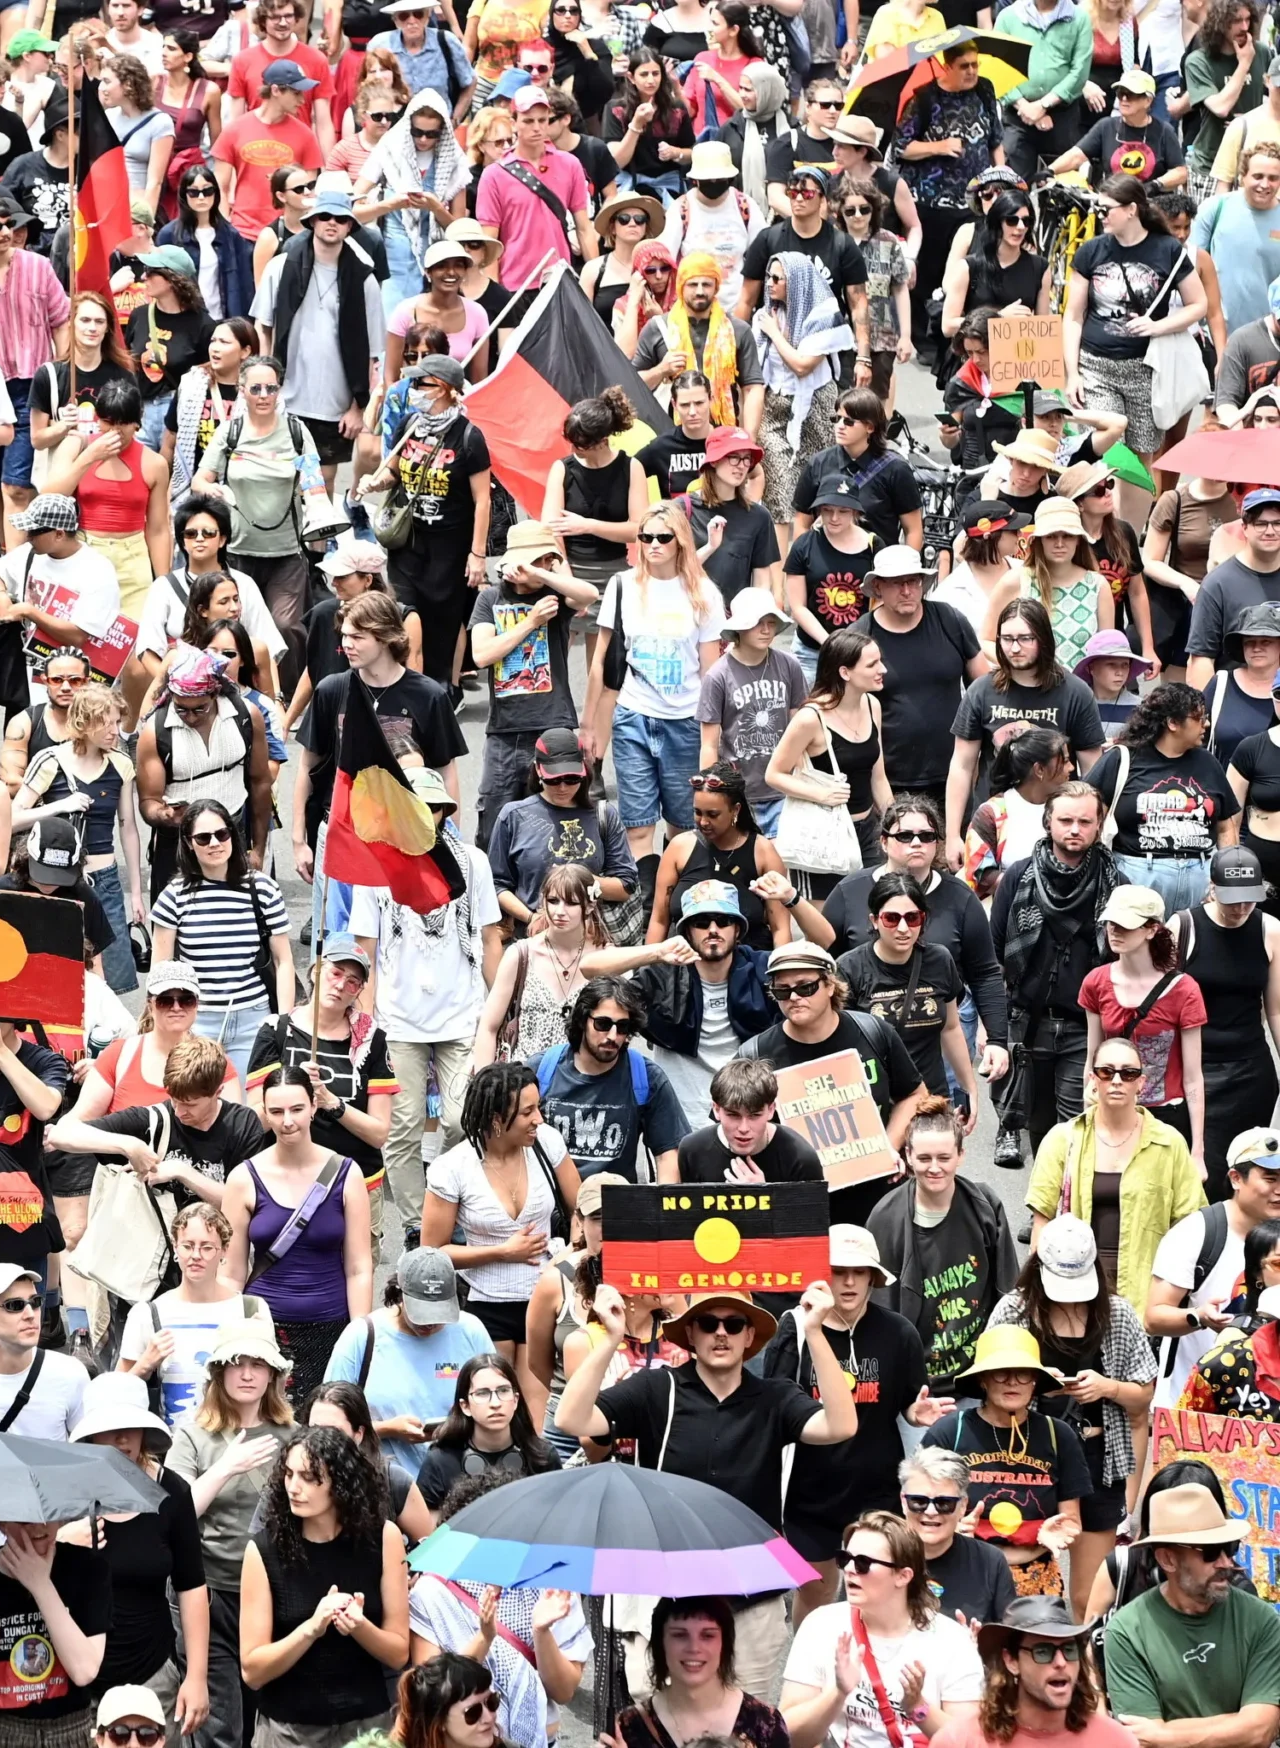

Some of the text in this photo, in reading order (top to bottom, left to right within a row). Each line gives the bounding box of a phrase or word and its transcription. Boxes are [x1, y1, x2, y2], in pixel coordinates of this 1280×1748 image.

[992, 320, 1058, 340] NO PRIDE
[1016, 340, 1035, 358] IN
[991, 359, 1061, 382] GENOCIDE
[669, 452, 706, 473] AUSTR
[823, 586, 857, 608] Yes
[989, 704, 1059, 726] MEGADETH
[804, 1103, 860, 1150] NOT
[662, 1195, 771, 1210] NO PRIDE
[630, 1271, 804, 1288] IN GENOCIDE
[923, 1262, 978, 1299] ALWAYS
[937, 1297, 972, 1322] WAS
[1235, 1384, 1270, 1411] Yes
[1152, 1407, 1280, 1464] ALWAYS
[4, 1624, 37, 1638] DUNGAY
